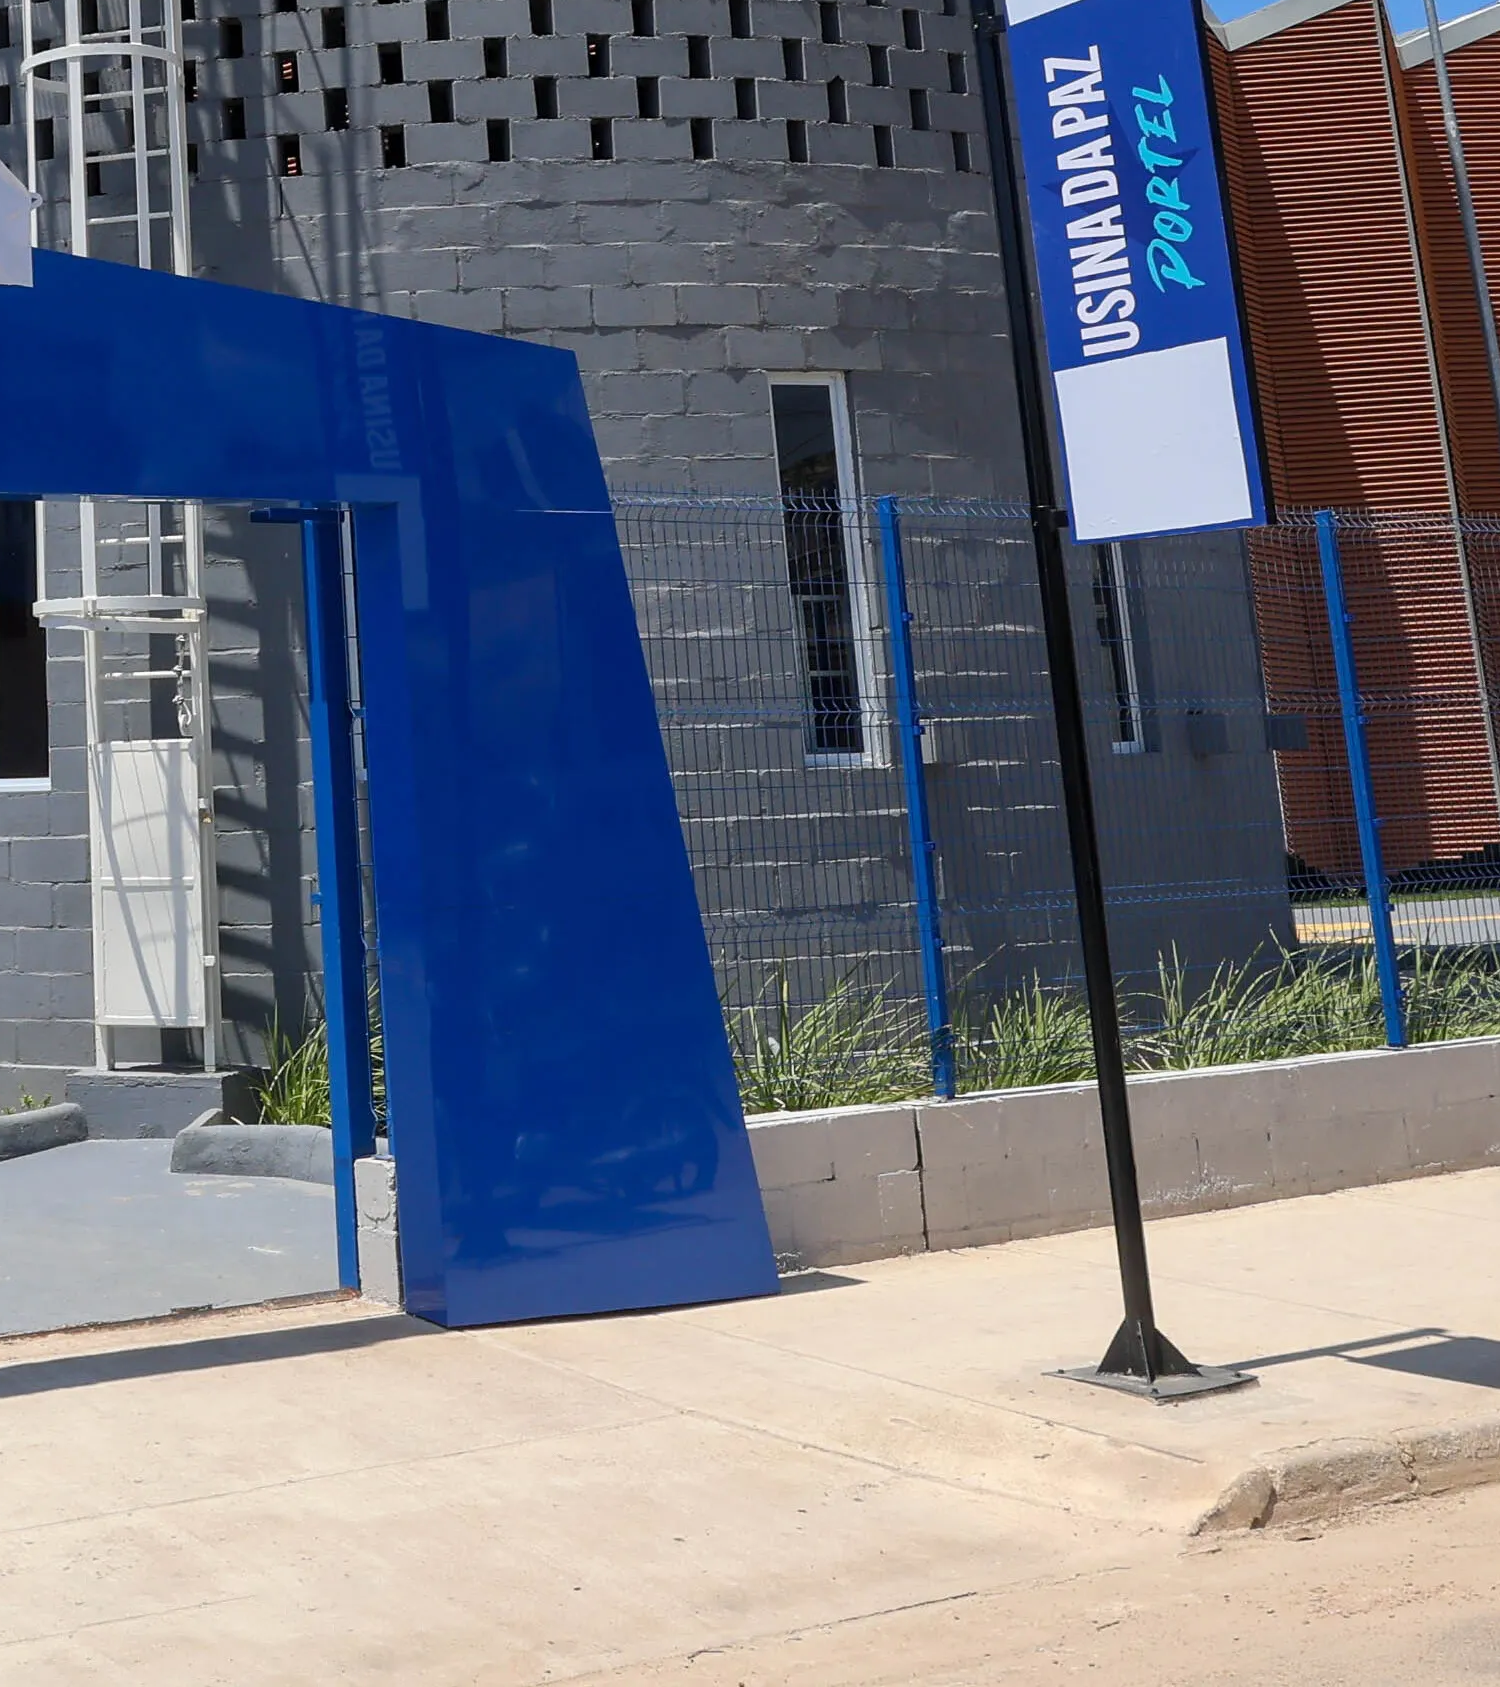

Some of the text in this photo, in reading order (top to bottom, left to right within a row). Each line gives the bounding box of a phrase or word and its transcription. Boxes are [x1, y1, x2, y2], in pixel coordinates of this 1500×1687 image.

[1043, 44, 1141, 357] USINA DA PAZ
[1131, 73, 1206, 293] PORTEL
